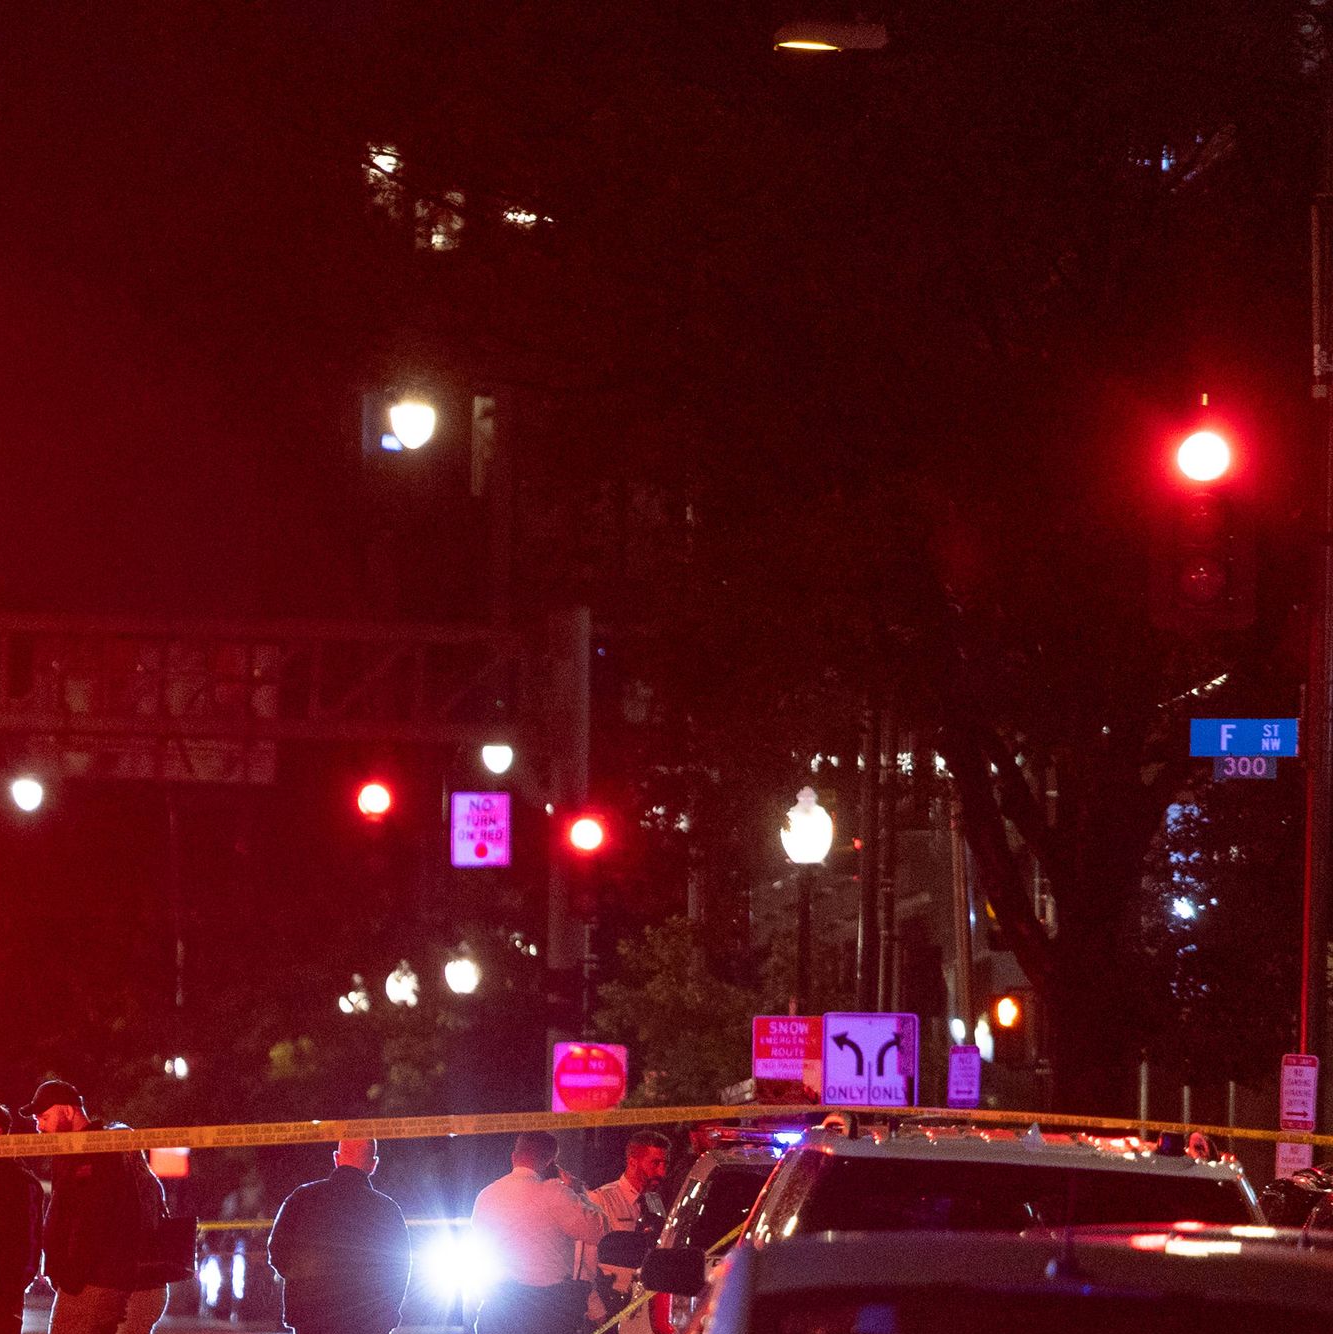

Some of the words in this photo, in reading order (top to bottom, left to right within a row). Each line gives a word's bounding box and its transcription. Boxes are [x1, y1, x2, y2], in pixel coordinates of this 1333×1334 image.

[1221, 724, 1236, 751] F
[1263, 724, 1280, 737] ST
[1261, 738, 1281, 751] NW
[1223, 757, 1267, 776] 300
[470, 799, 492, 811] NO
[467, 815, 496, 826] TURN
[480, 829, 503, 841] RED
[768, 1021, 809, 1034] SNOW
[771, 1047, 805, 1057] ROUTE
[827, 1086, 867, 1099] ONLY
